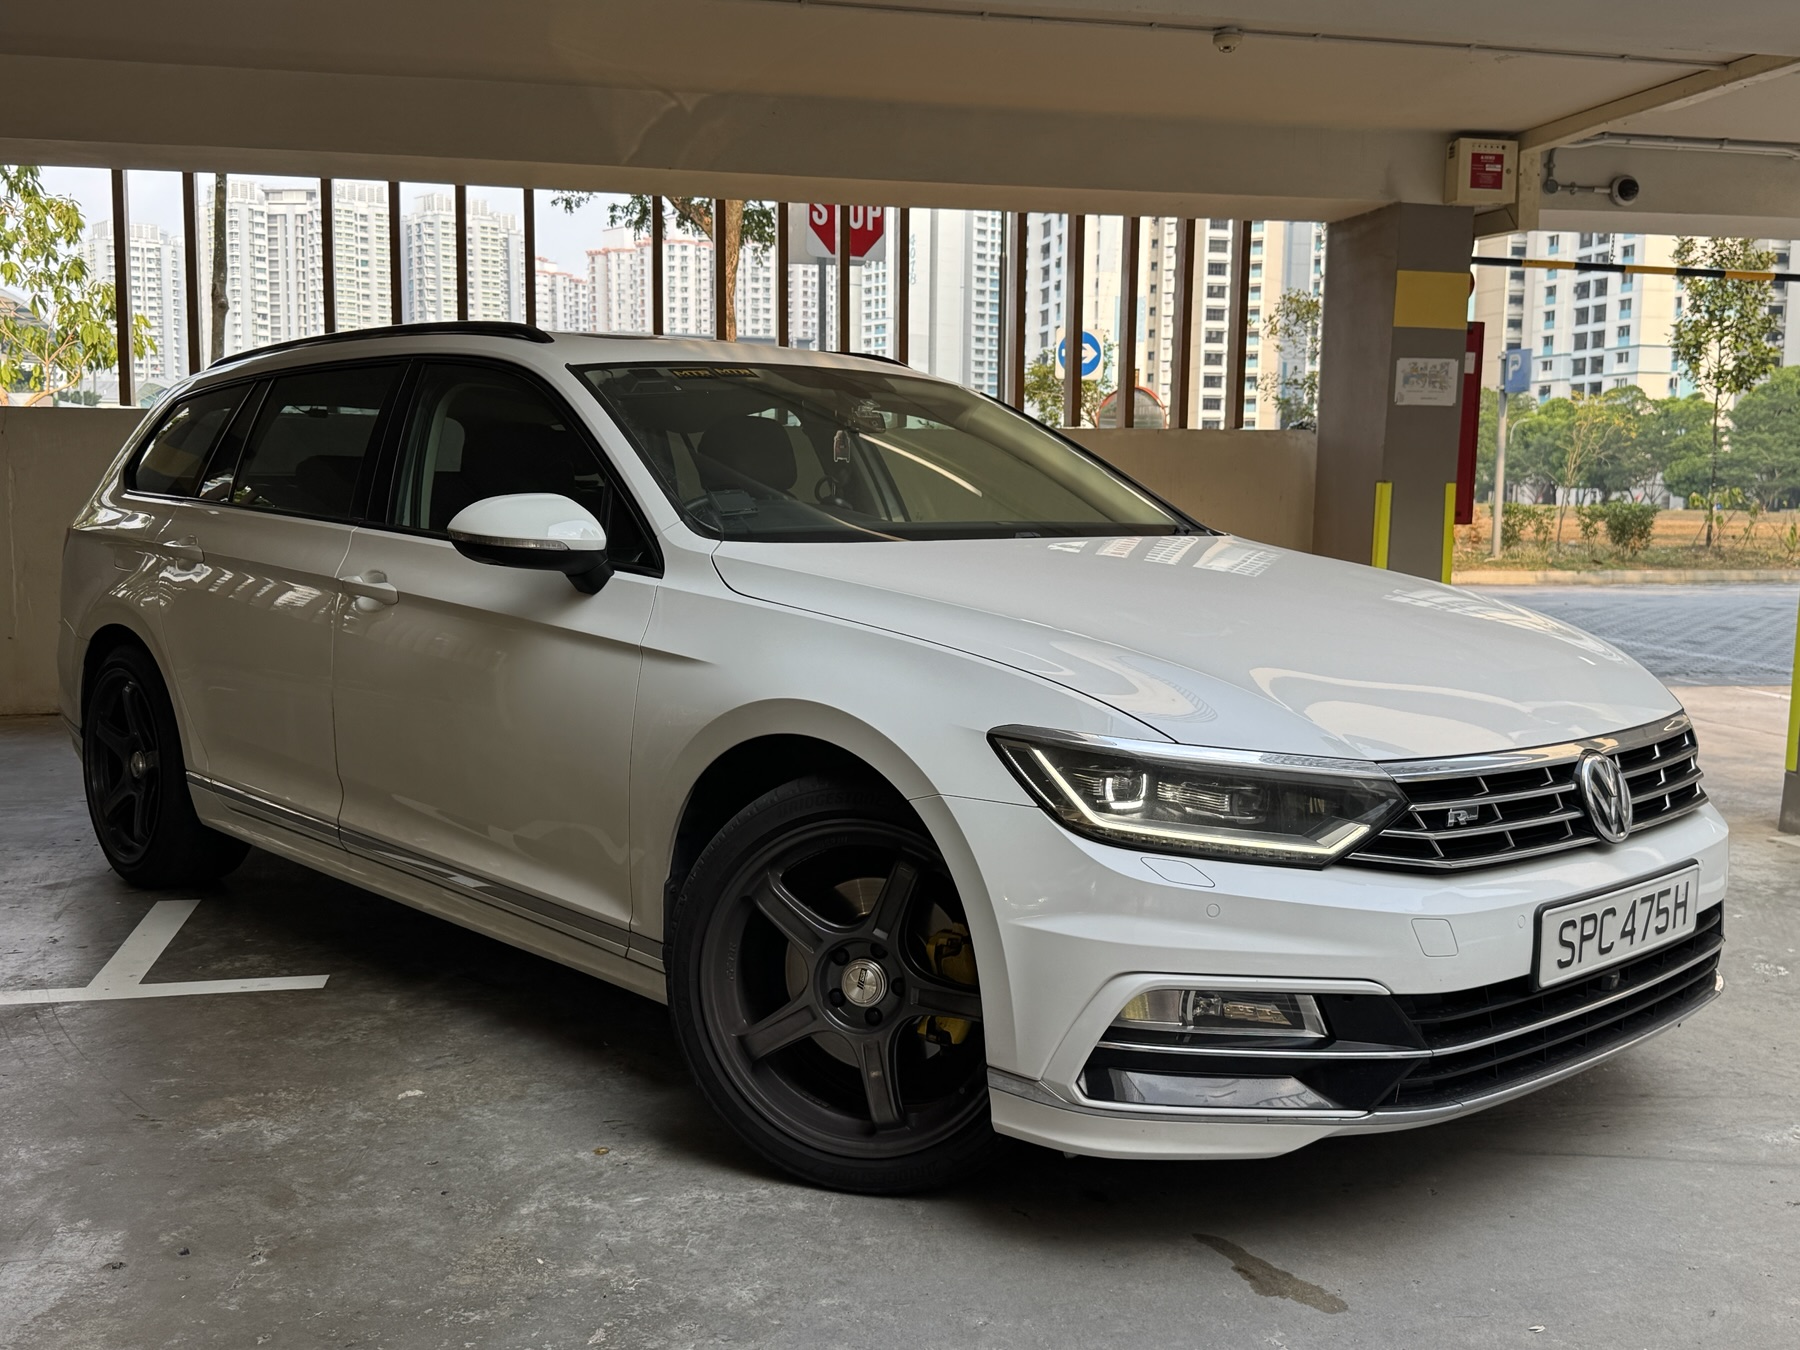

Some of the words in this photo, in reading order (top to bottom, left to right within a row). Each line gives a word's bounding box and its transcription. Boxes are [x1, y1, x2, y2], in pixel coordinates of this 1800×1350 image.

[811, 203, 882, 231] SOP
[1508, 354, 1522, 381] P
[1557, 881, 1690, 969] SPC475H
